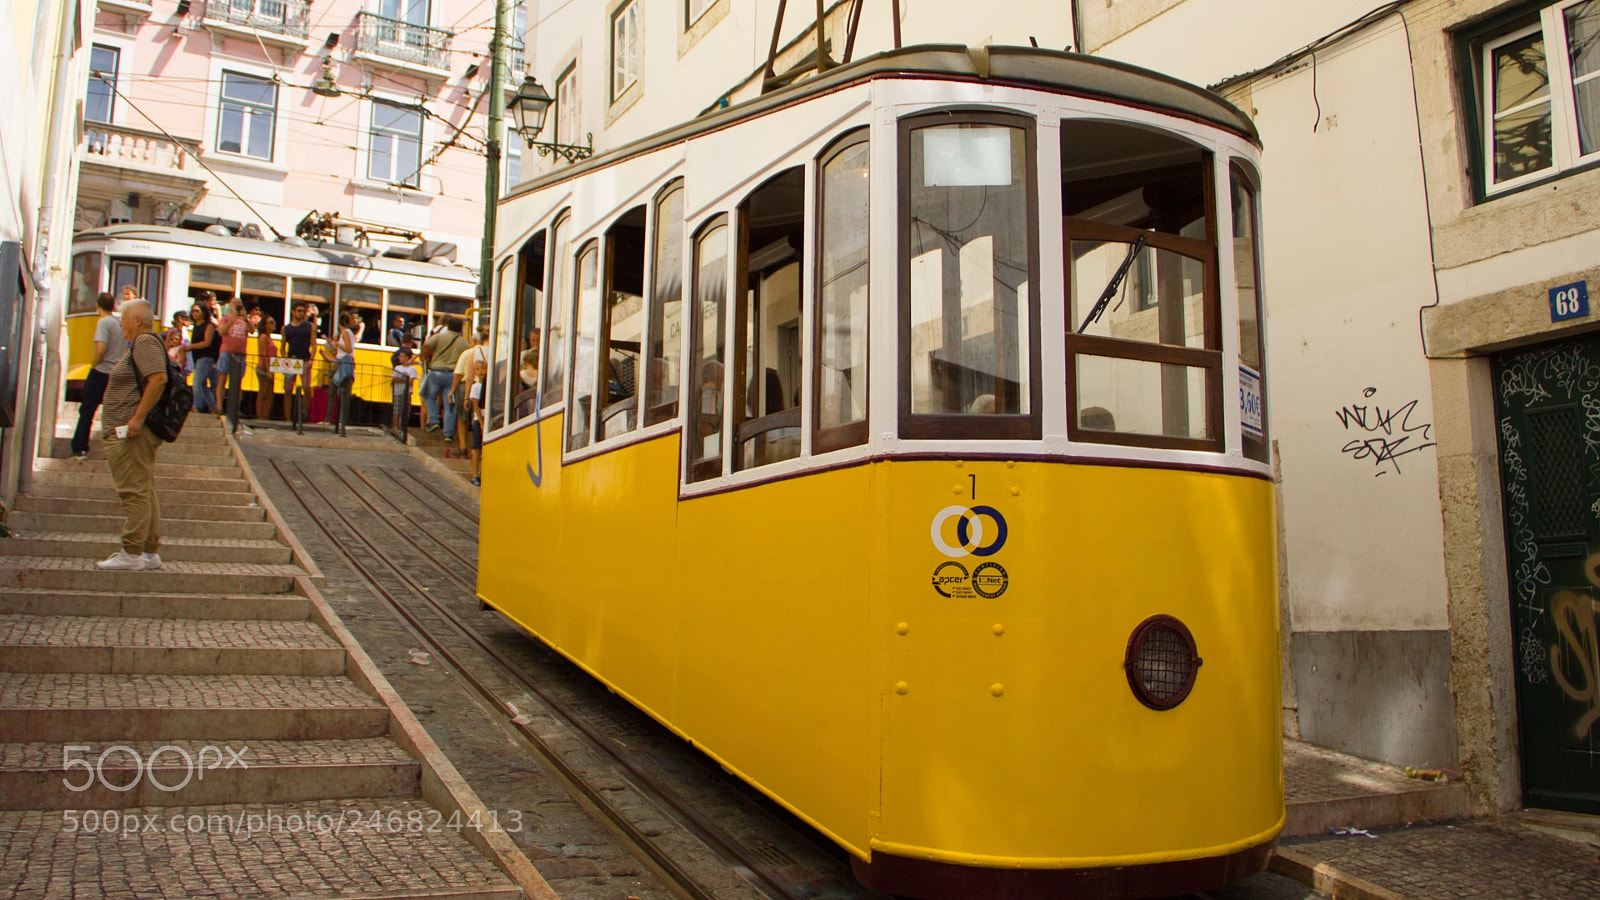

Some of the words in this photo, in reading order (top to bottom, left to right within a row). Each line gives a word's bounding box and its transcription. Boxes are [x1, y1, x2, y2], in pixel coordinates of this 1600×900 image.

[1556, 287, 1579, 316] 68
[968, 474, 976, 500] 1
[938, 576, 964, 585] apcer
